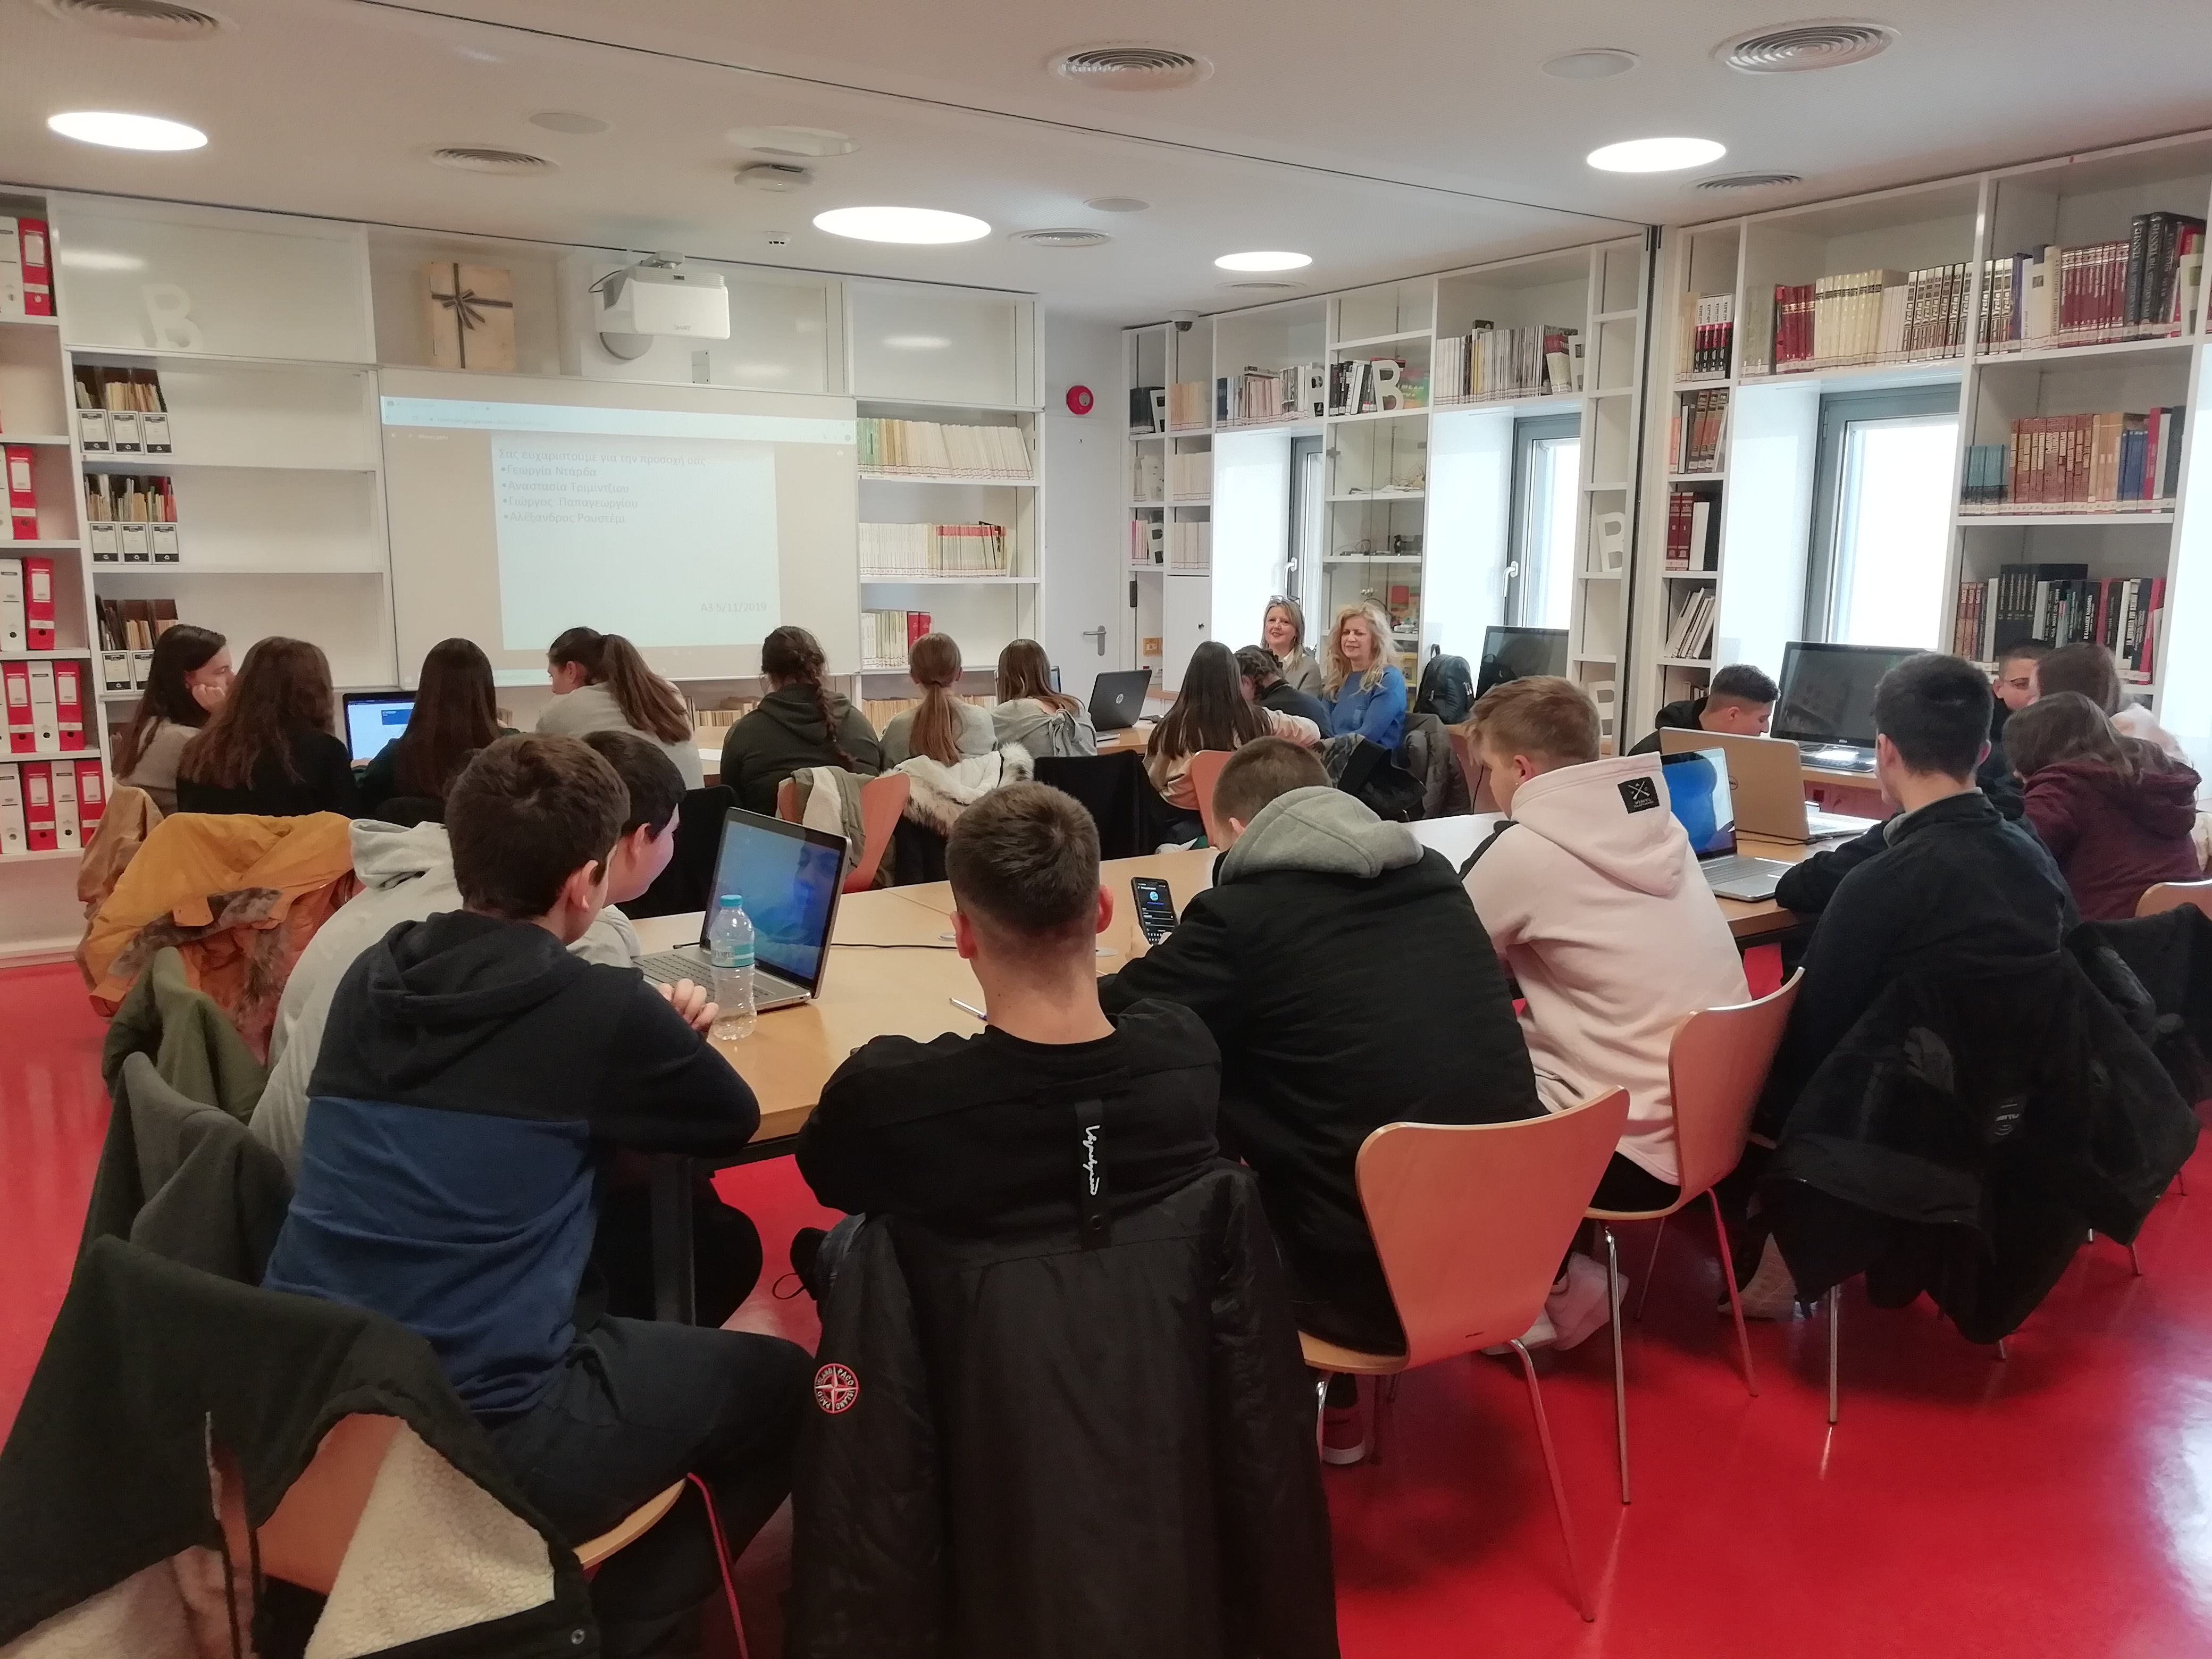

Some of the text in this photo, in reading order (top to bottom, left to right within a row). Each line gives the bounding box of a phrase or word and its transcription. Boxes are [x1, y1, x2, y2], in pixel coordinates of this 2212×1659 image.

[141, 283, 204, 351] B
[1372, 359, 1404, 412] B
[499, 448, 706, 466] Σας ευχαριστούμε για την προσοχή σας
[507, 464, 597, 476] Γεωργία Ντάρδα
[508, 481, 567, 491] Αναστασία
[509, 496, 638, 509] Γιώργος Παπαγεωργίου
[509, 512, 626, 524] Αλέξανδρος Ρουστέμι
[716, 602, 766, 613] 5/11/2019
[817, 1367, 833, 1385] ISLAND
[837, 1368, 854, 1386] PACO
[817, 1390, 831, 1409] PACO
[835, 1389, 854, 1410] ISLAND
